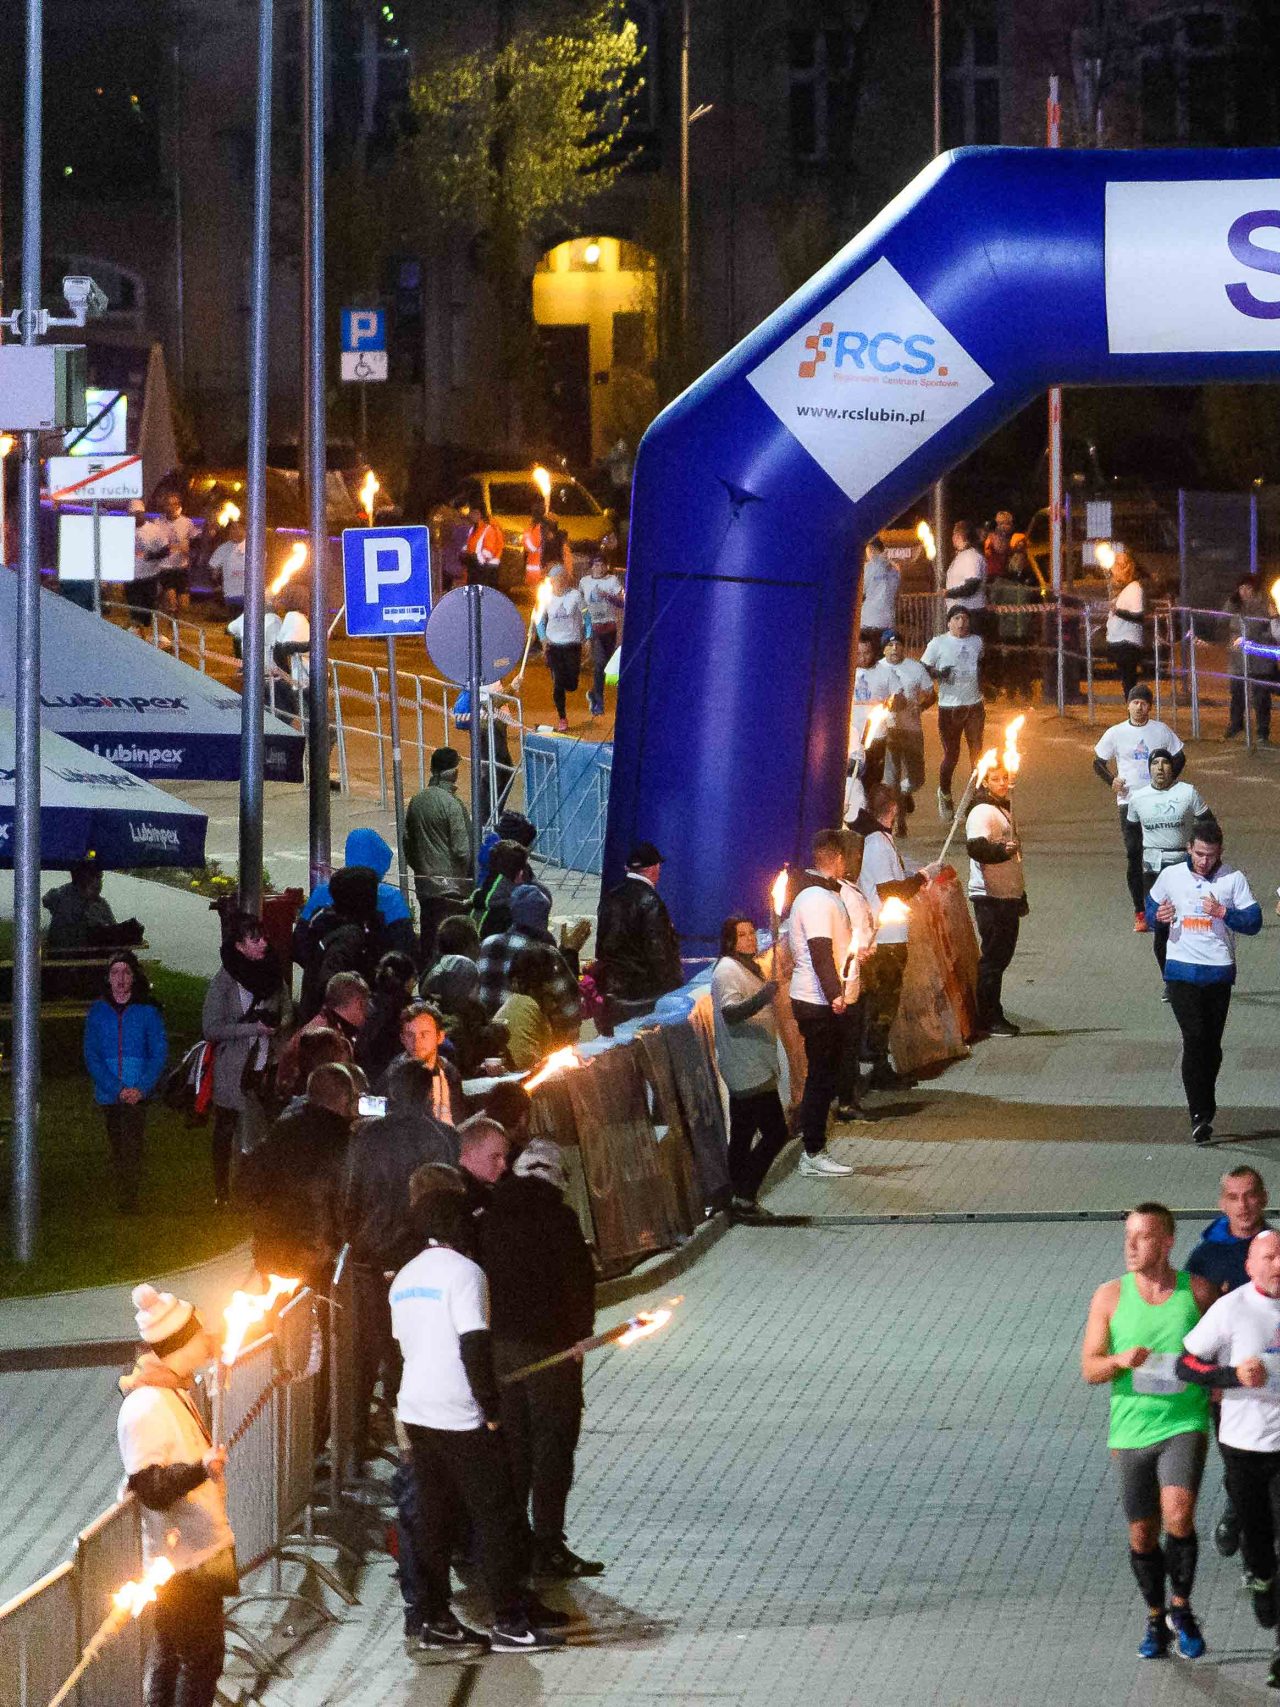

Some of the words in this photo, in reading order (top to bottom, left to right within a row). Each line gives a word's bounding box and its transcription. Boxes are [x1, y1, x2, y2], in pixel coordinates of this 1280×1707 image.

[351, 311, 377, 348] P
[797, 405, 925, 425] www.rcslubin.pl
[363, 537, 412, 604] P
